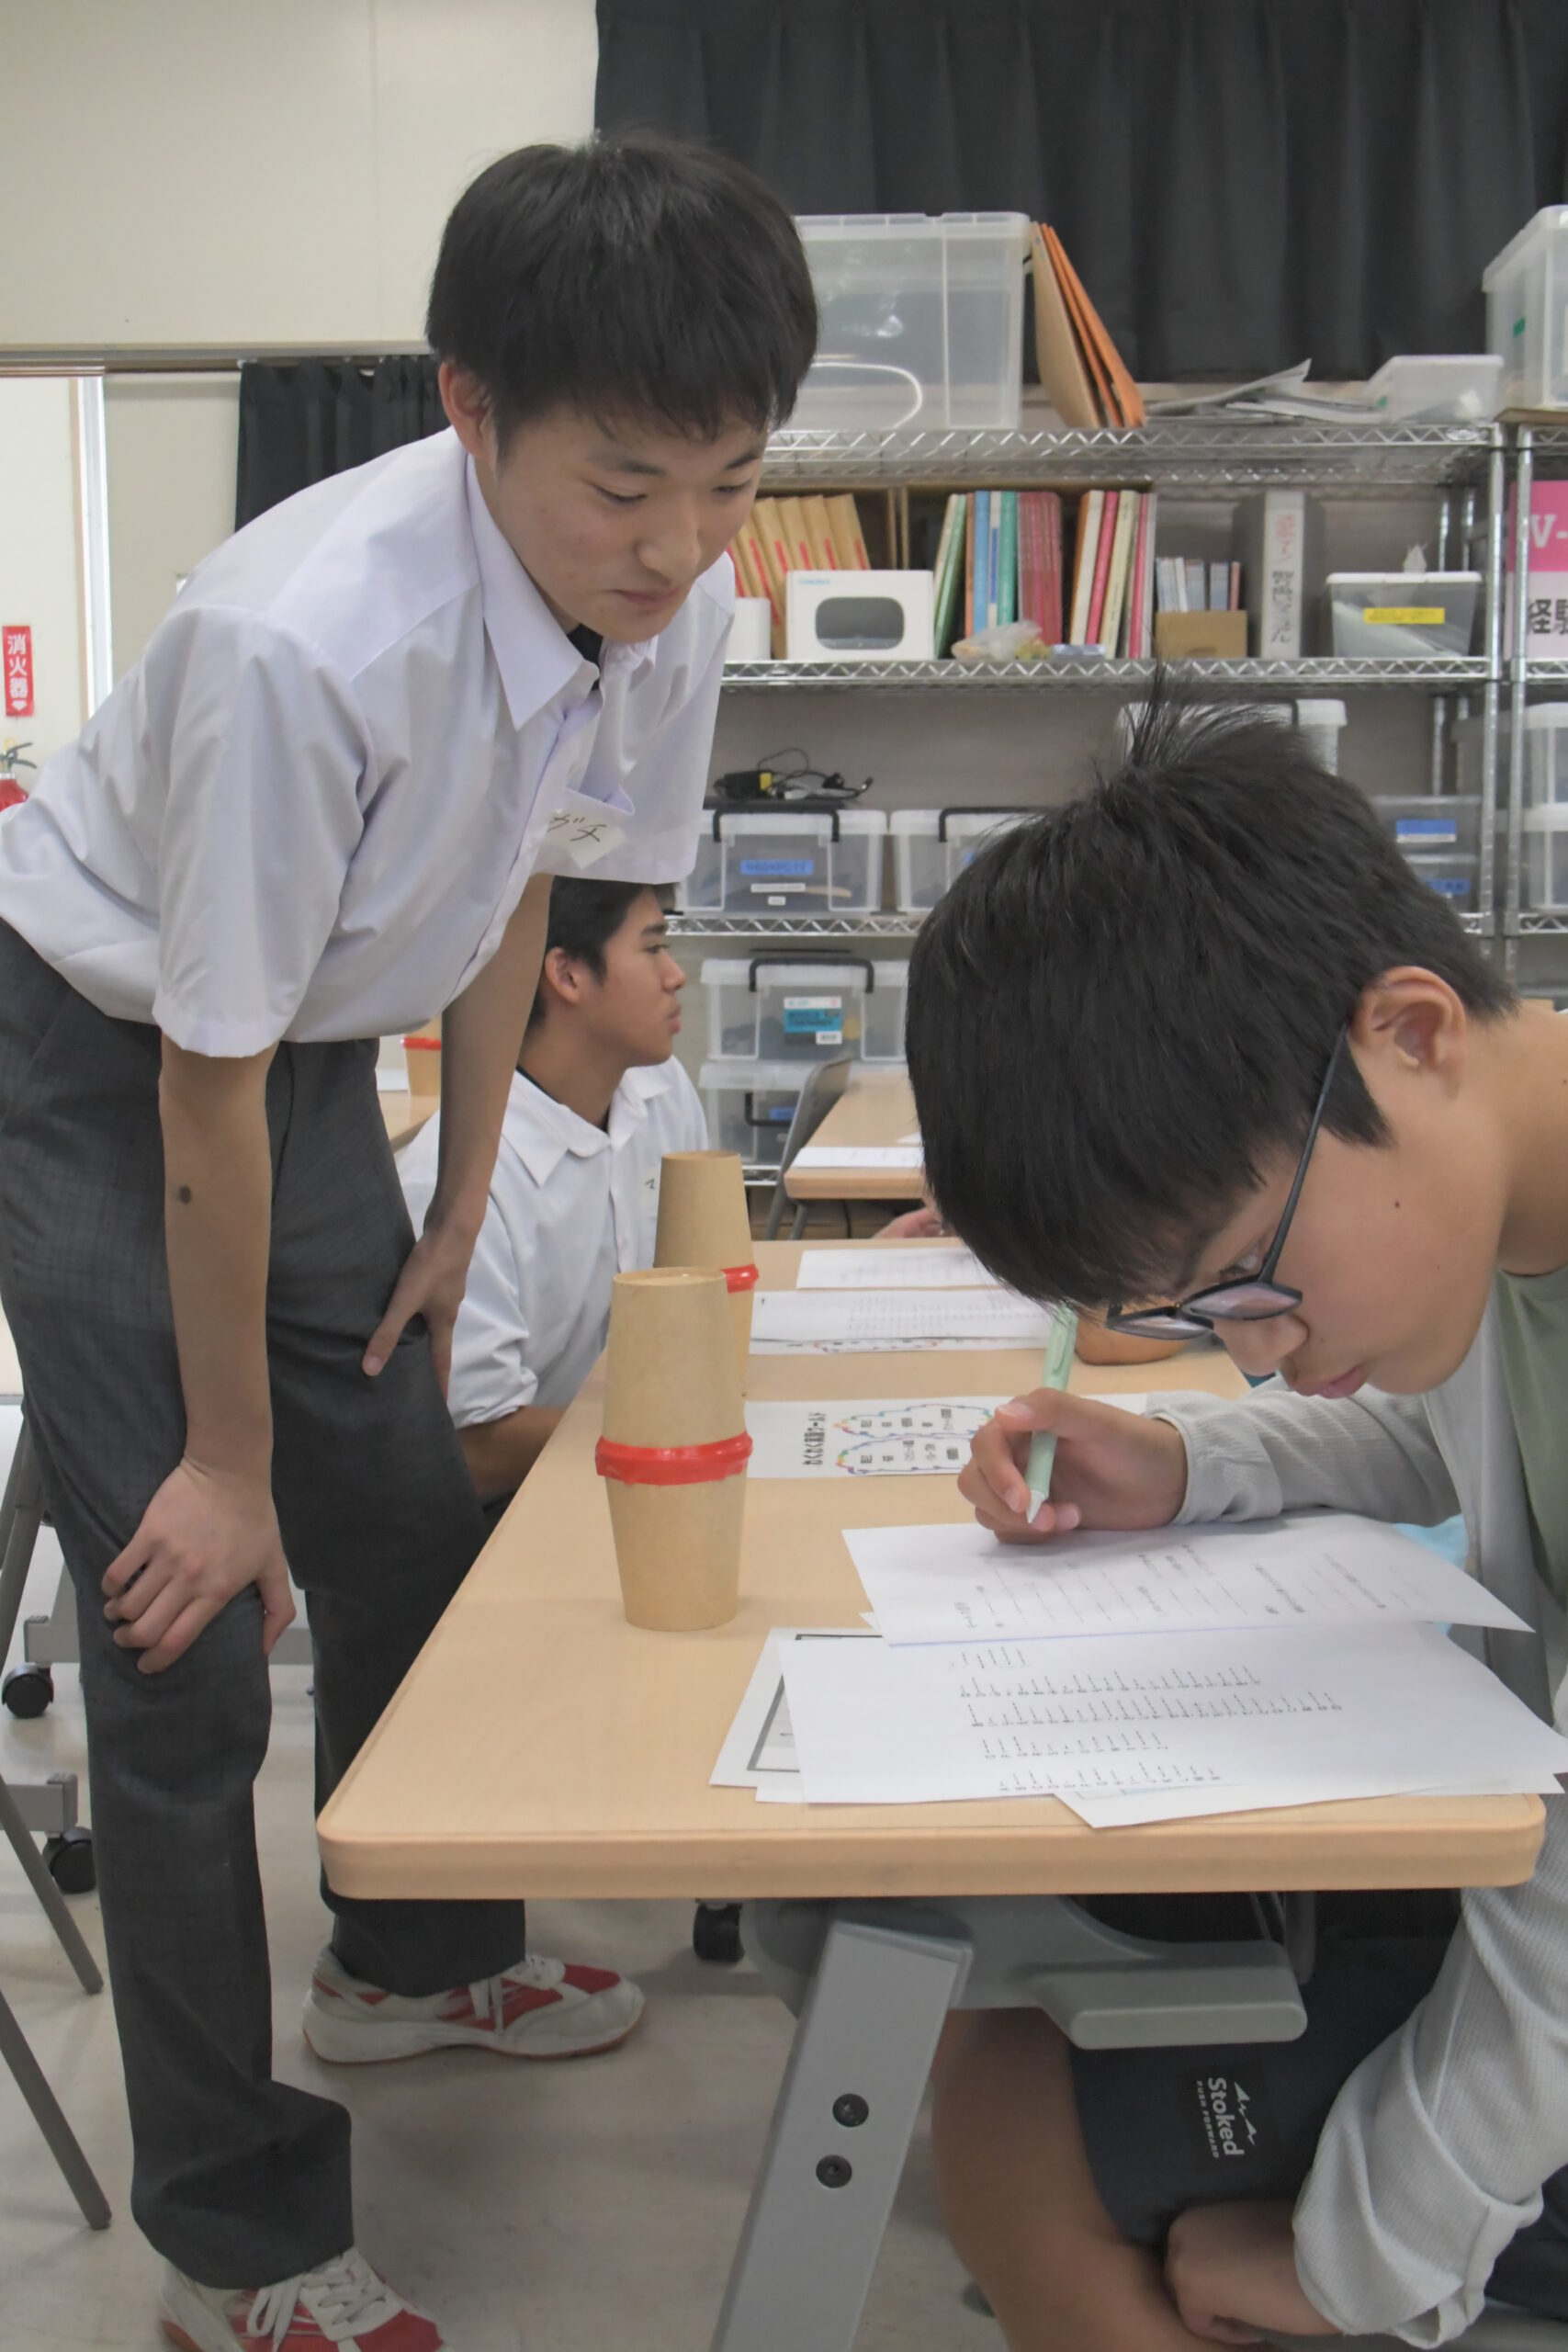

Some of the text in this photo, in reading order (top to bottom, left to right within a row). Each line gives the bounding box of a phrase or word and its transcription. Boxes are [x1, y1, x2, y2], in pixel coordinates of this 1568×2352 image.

[7, 634, 28, 698] 消火器
[1196, 2080, 1220, 2158] PUSH FORWARD
[1208, 2077, 1245, 2155] Stoked
